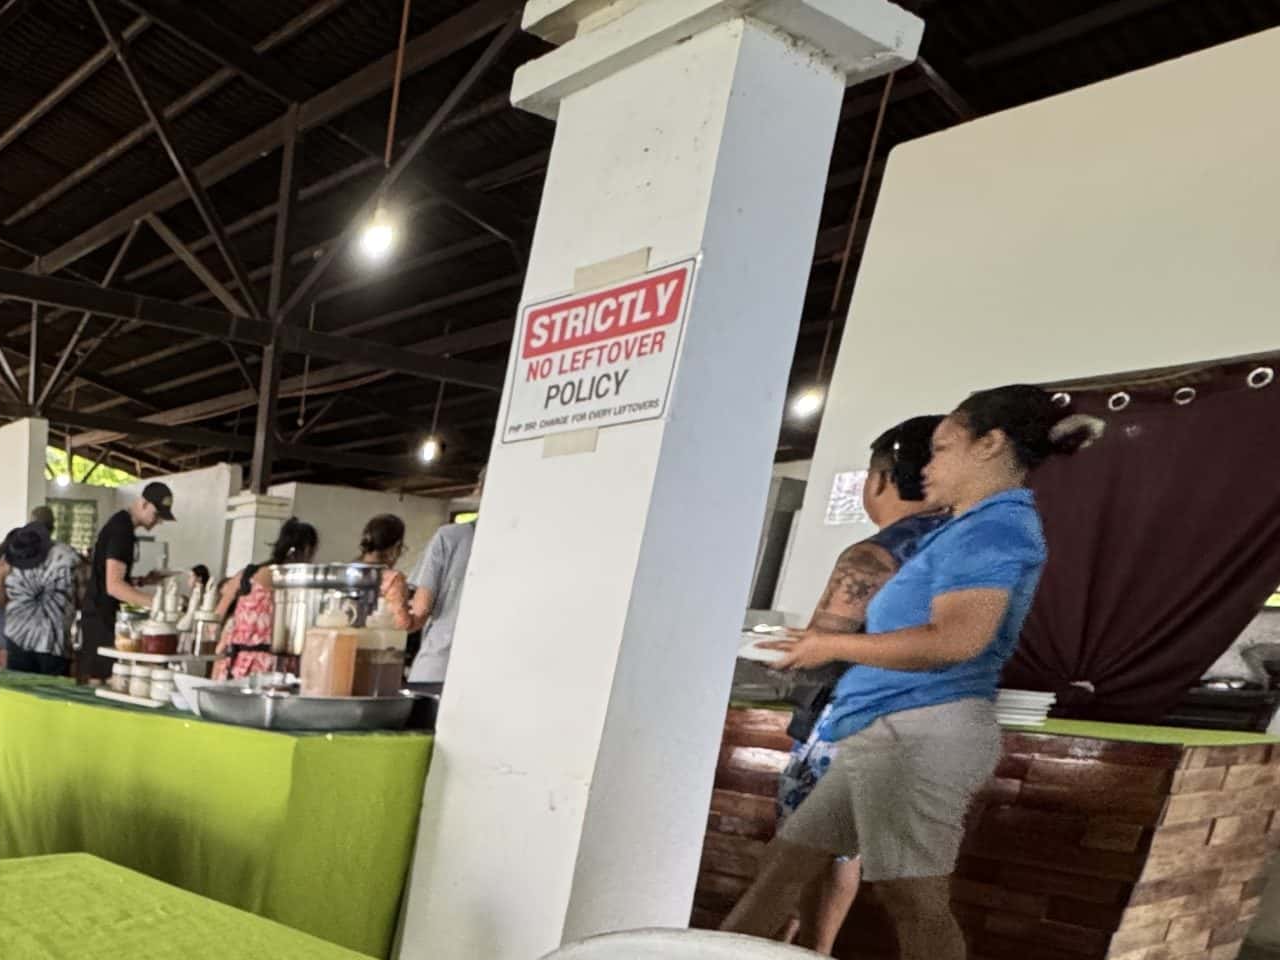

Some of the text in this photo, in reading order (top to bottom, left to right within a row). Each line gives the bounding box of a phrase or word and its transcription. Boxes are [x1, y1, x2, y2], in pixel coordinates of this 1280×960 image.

[530, 279, 679, 348] STRICTLY
[526, 331, 666, 382] NO LEFTOVER
[544, 369, 629, 409] POLICY
[539, 415, 570, 428] CHARGE
[571, 412, 587, 423] FOR
[588, 408, 612, 420] EVERY
[613, 399, 660, 416] LEFTOVERS
